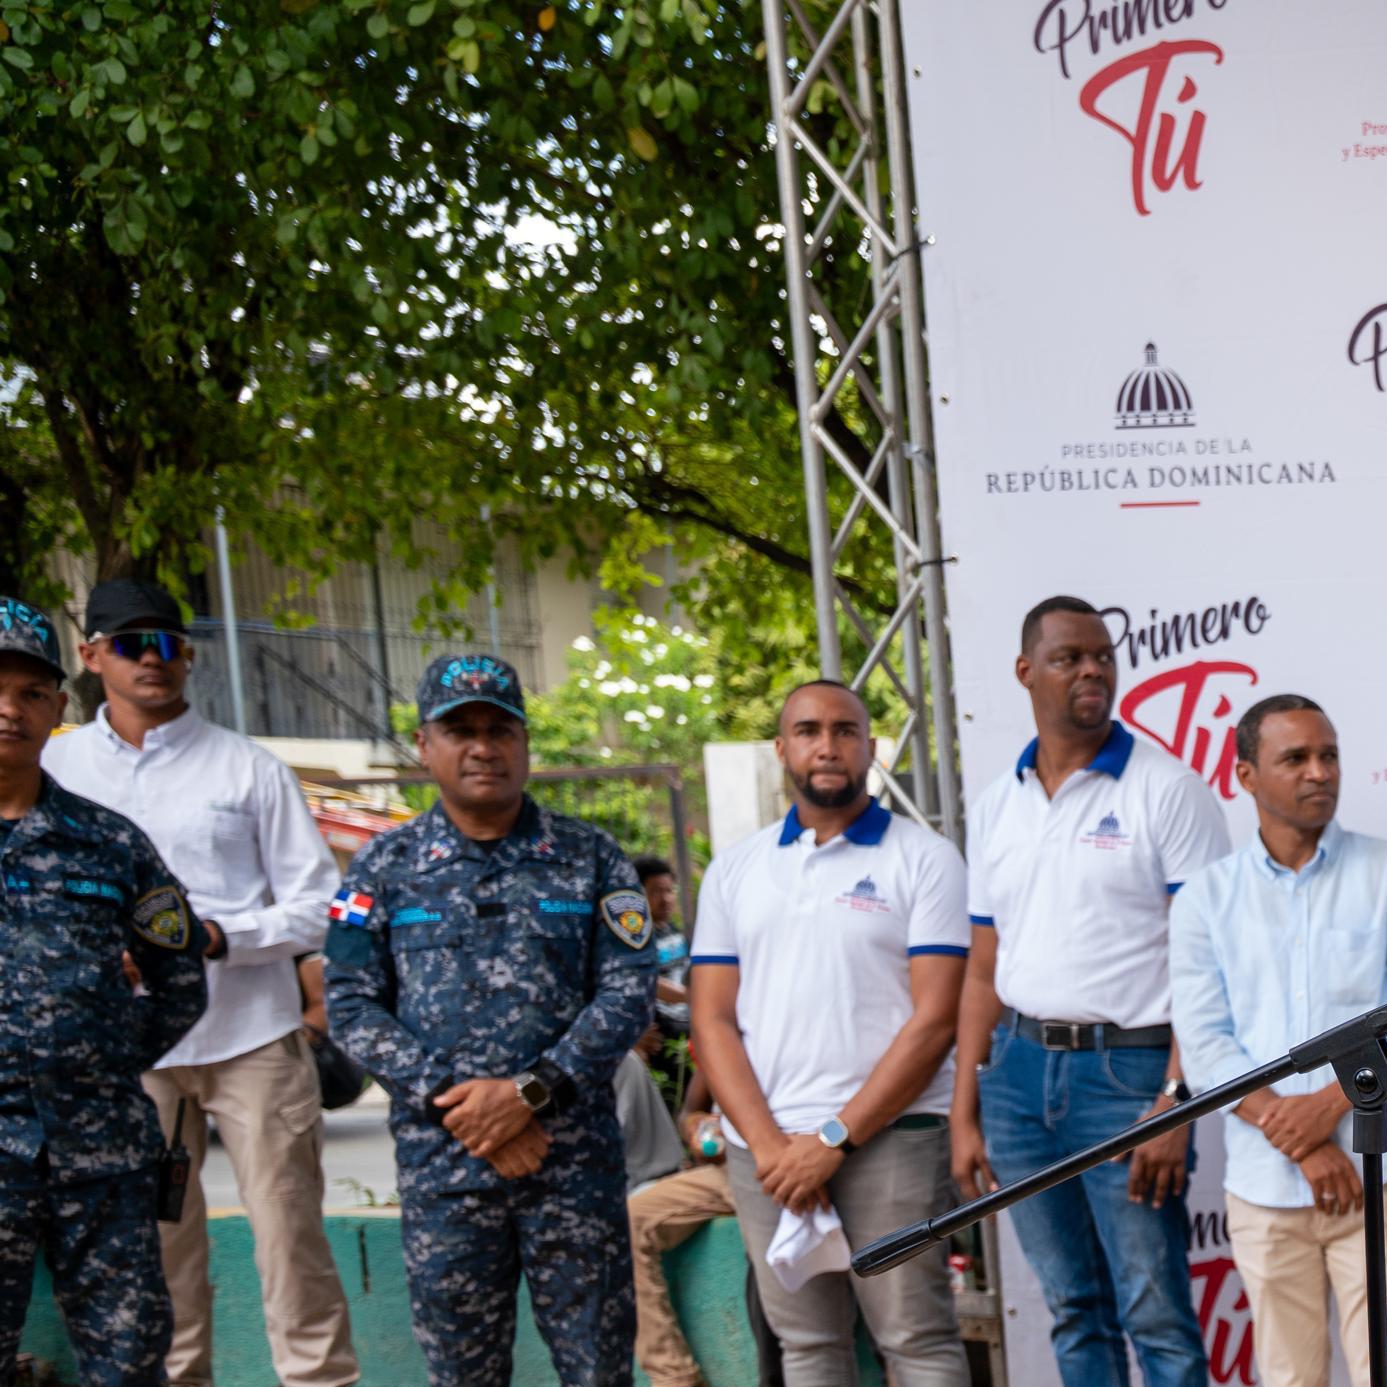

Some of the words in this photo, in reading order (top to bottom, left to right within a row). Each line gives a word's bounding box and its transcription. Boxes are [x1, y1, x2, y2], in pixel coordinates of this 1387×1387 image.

[1079, 40, 1224, 217] Tú
[1341, 147, 1349, 161] y
[1061, 440, 1188, 459] PRESIDENCIA
[1195, 438, 1219, 455] DE
[1227, 438, 1252, 454] LA
[985, 466, 1139, 494] REPÚBLICA
[1149, 462, 1337, 488] DOMINICANA
